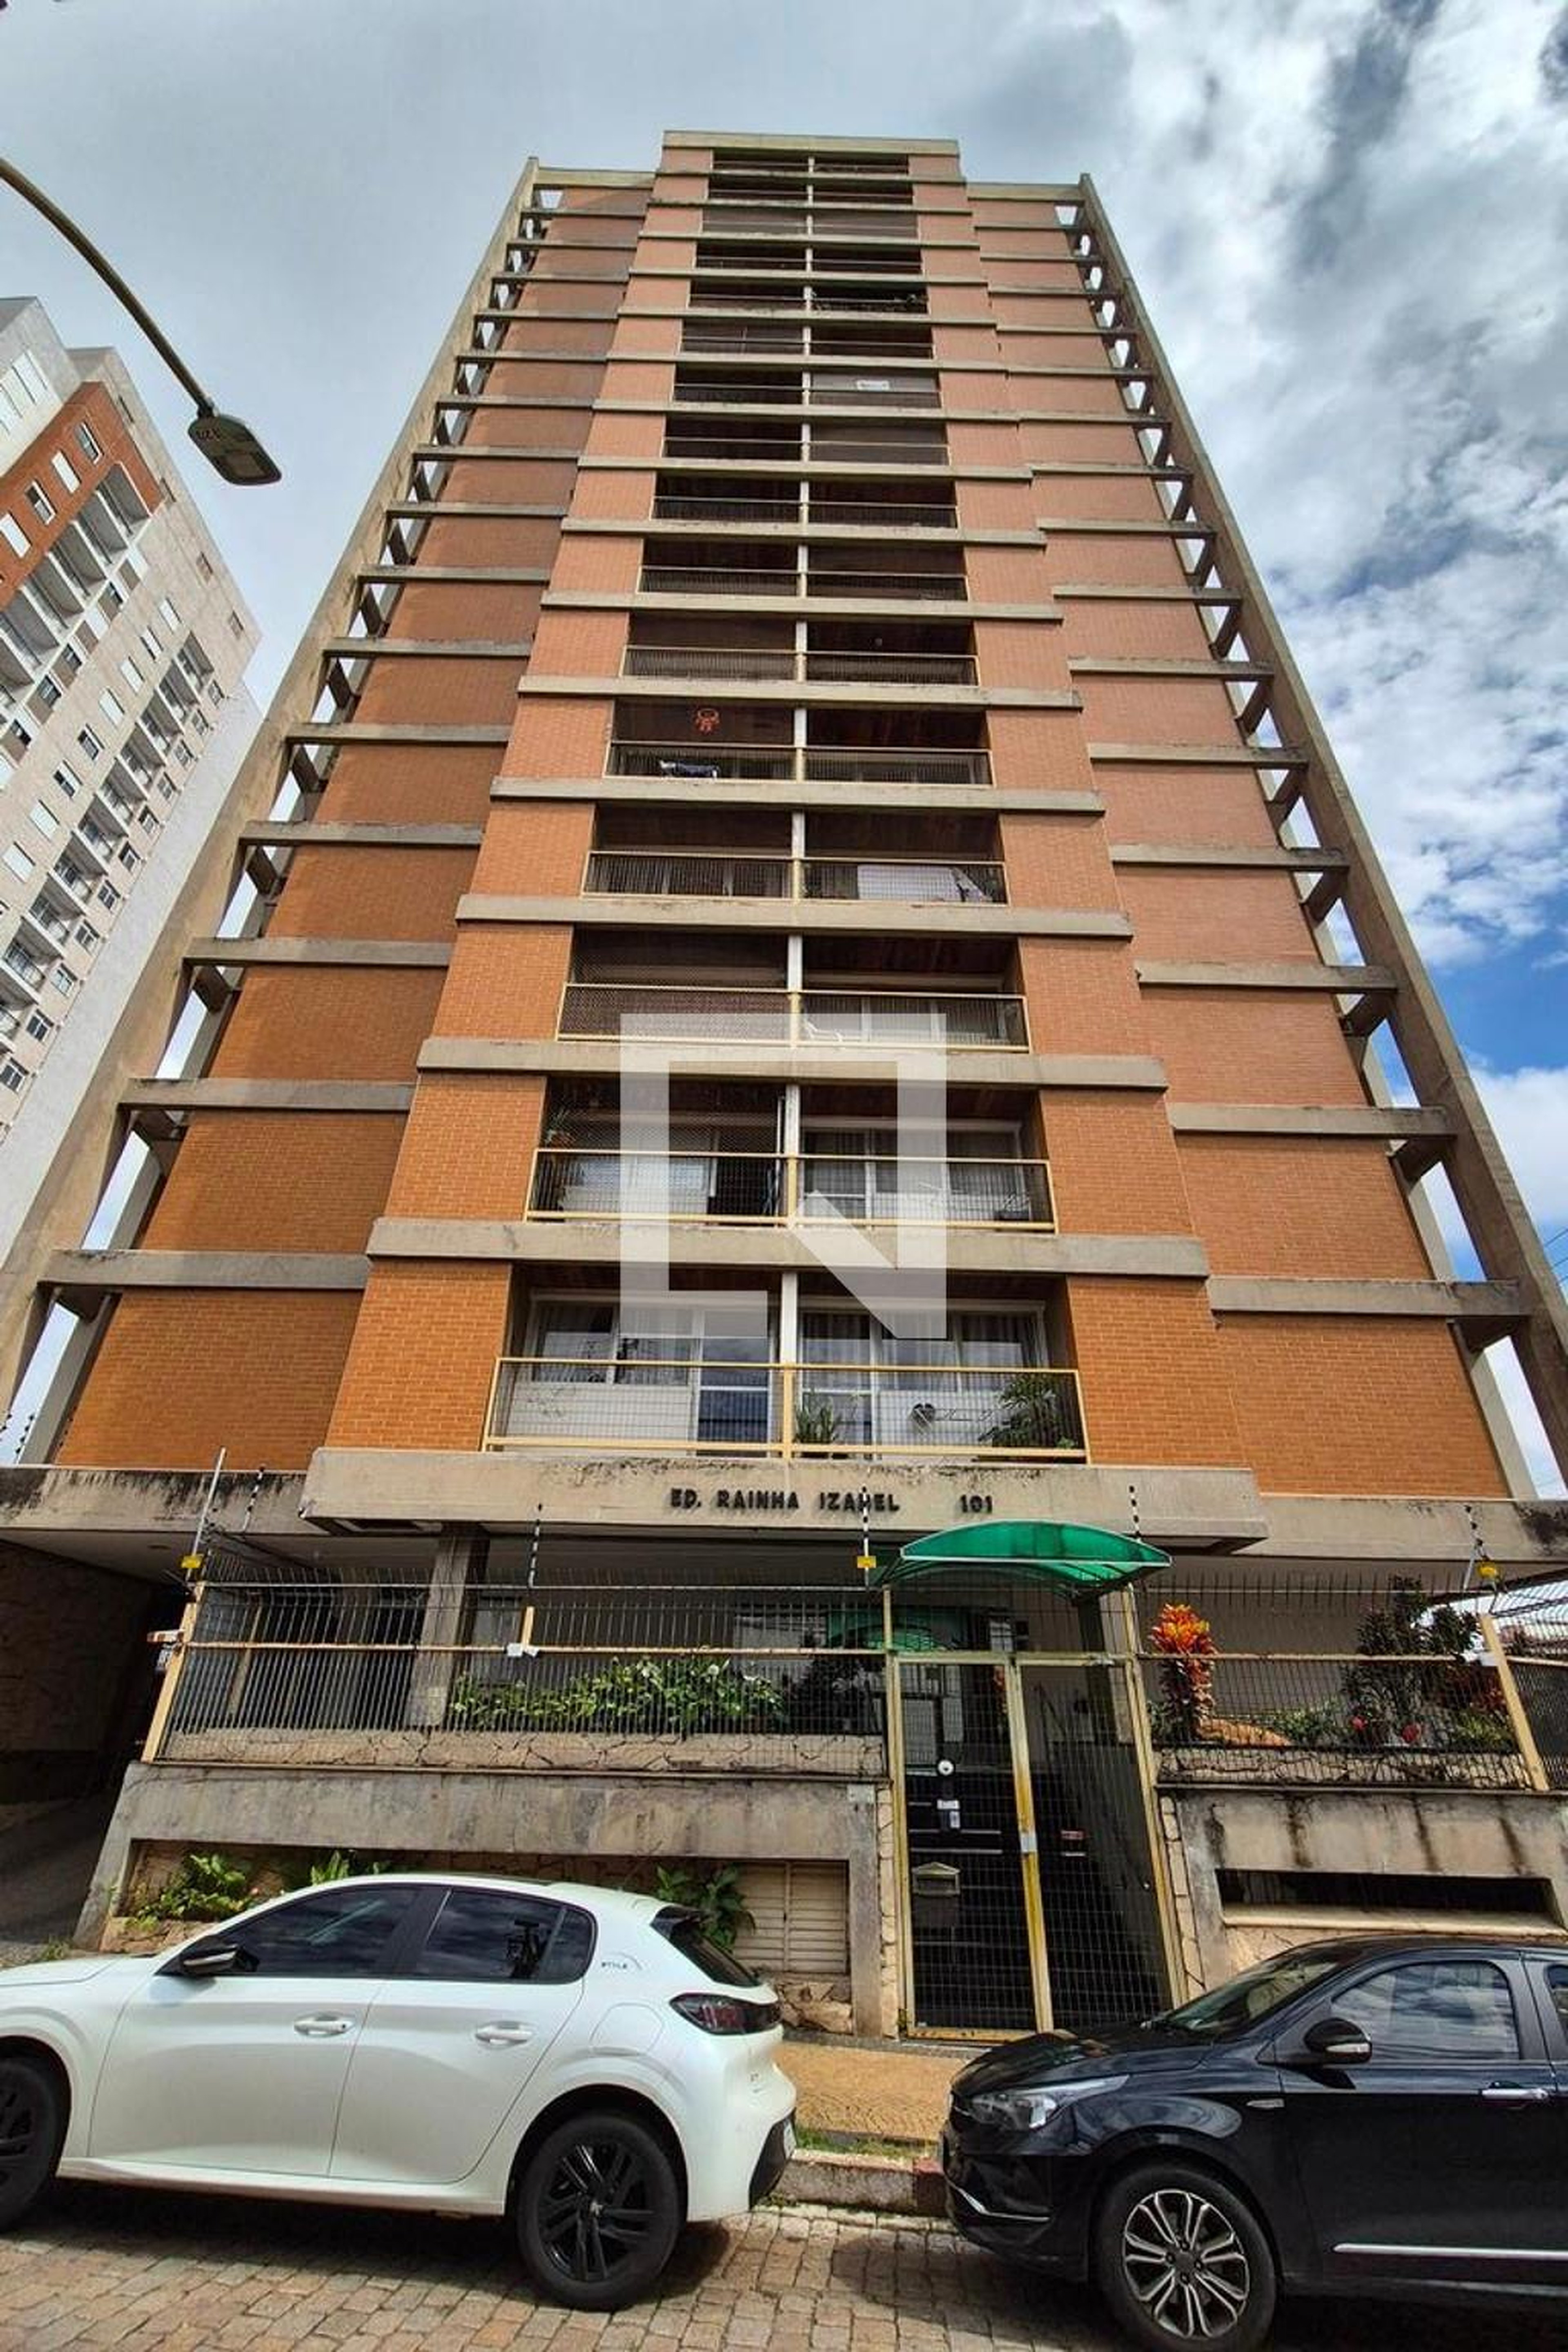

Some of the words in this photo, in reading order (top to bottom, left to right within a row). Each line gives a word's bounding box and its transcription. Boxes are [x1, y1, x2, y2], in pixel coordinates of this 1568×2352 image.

[670, 1488, 702, 1508] ED.
[717, 1490, 799, 1510] RAINHA
[960, 1494, 993, 1514] 101
